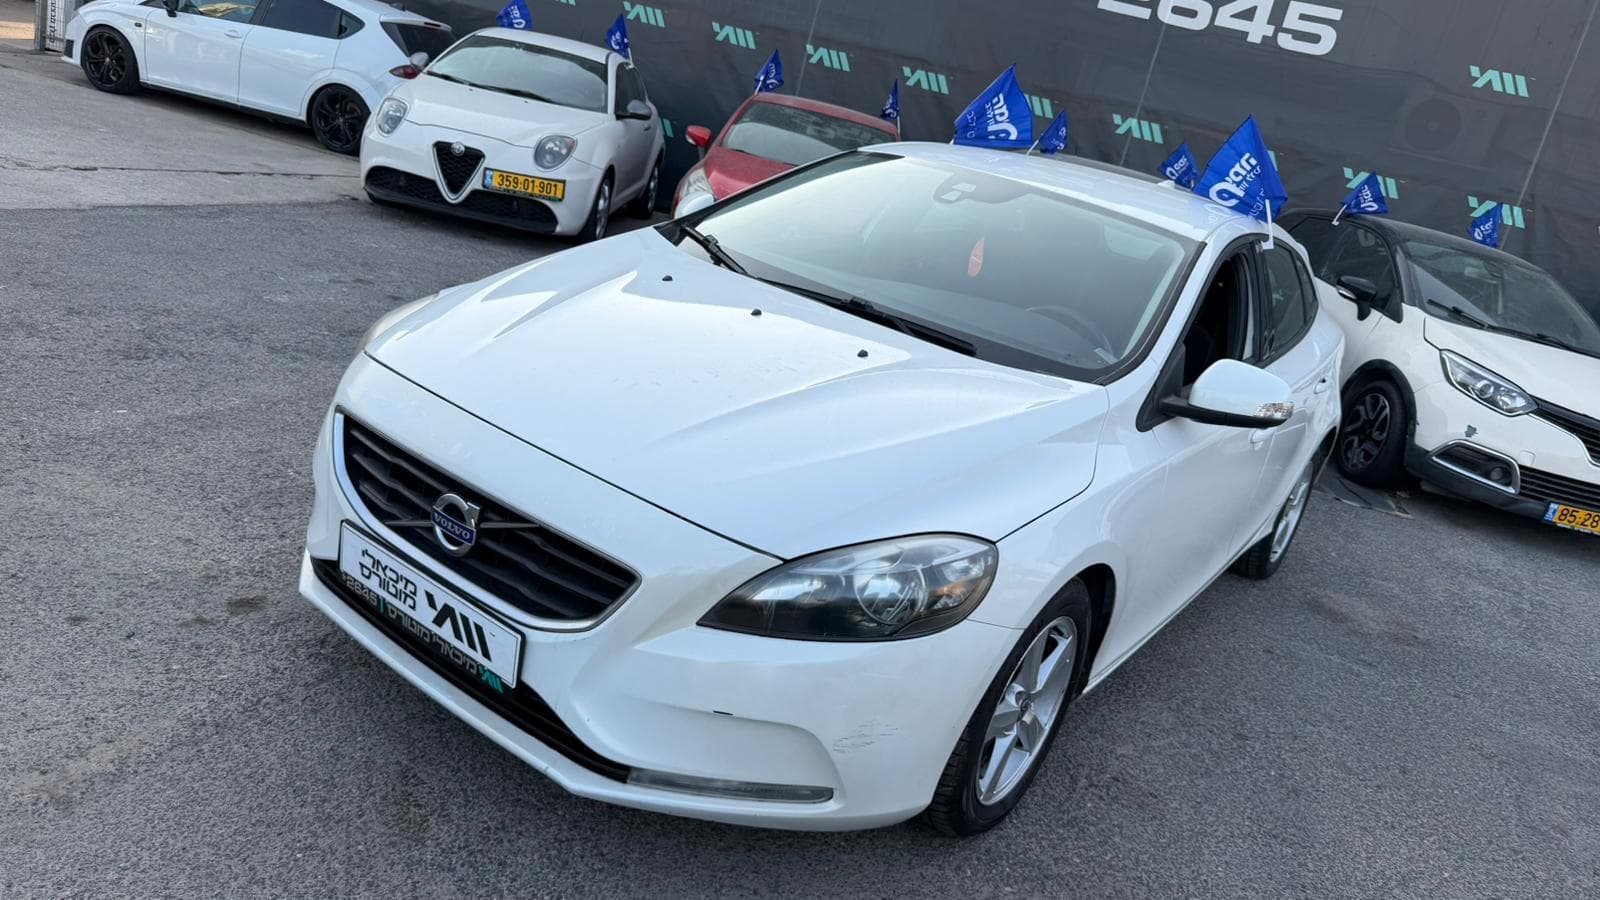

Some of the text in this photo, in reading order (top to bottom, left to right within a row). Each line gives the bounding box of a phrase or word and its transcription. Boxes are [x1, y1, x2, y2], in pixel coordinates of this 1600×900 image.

[434, 512, 471, 539] VOLVO
[359, 562, 416, 611] מוטורס
[361, 548, 417, 596] מיכאלי
[387, 603, 431, 643] מוטורס
[432, 633, 478, 675] מיכאלי
